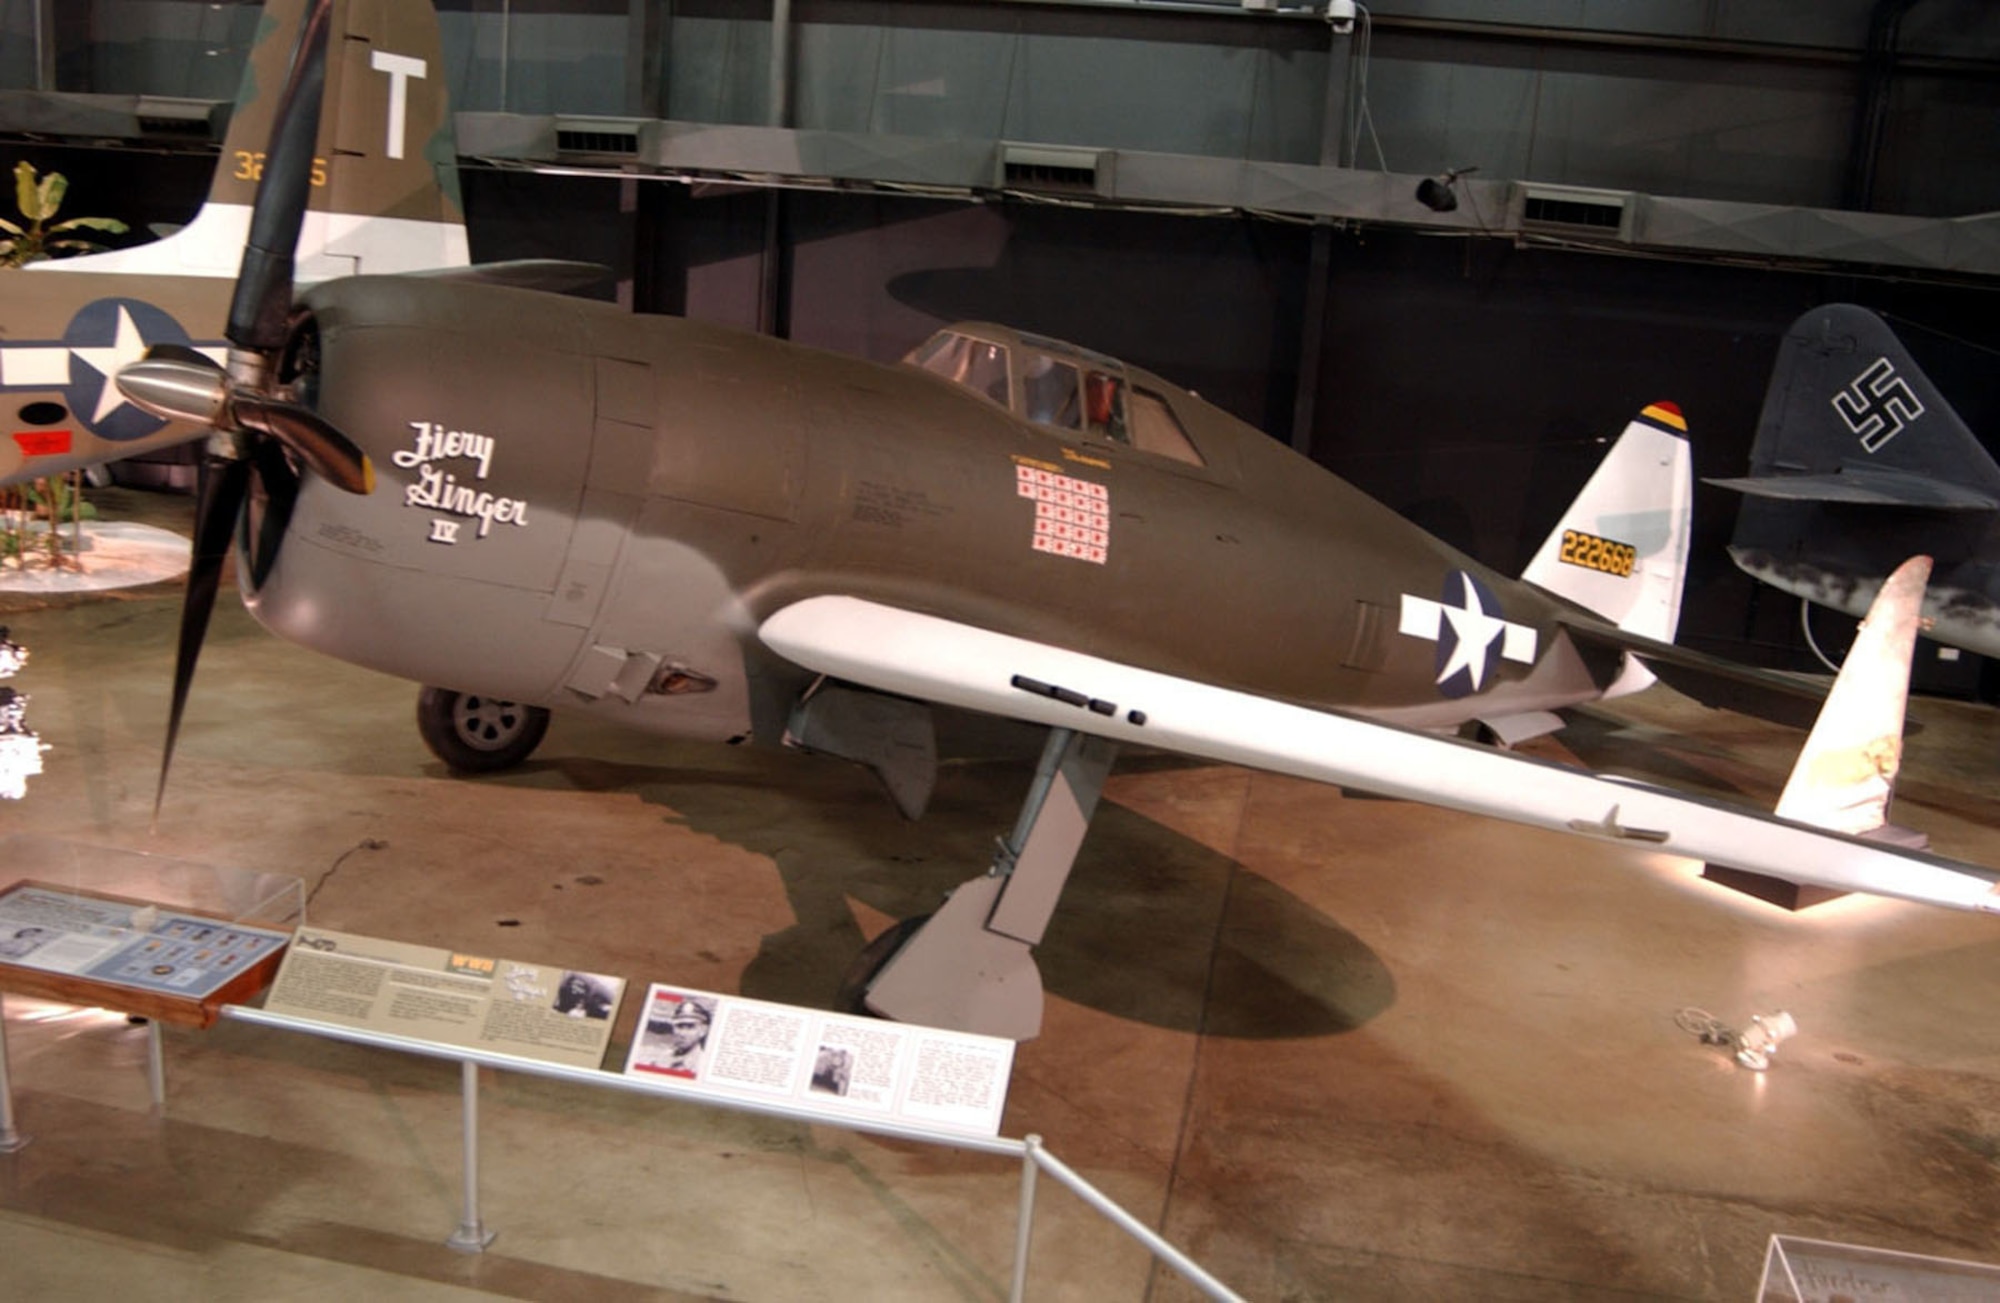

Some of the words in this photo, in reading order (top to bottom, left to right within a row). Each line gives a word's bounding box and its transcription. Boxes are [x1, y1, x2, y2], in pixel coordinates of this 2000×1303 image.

[371, 49, 427, 160] T
[392, 421, 495, 479] Fiery
[406, 463, 528, 537] Ginger
[430, 518, 461, 544] IV
[1561, 530, 1636, 578] 222668
